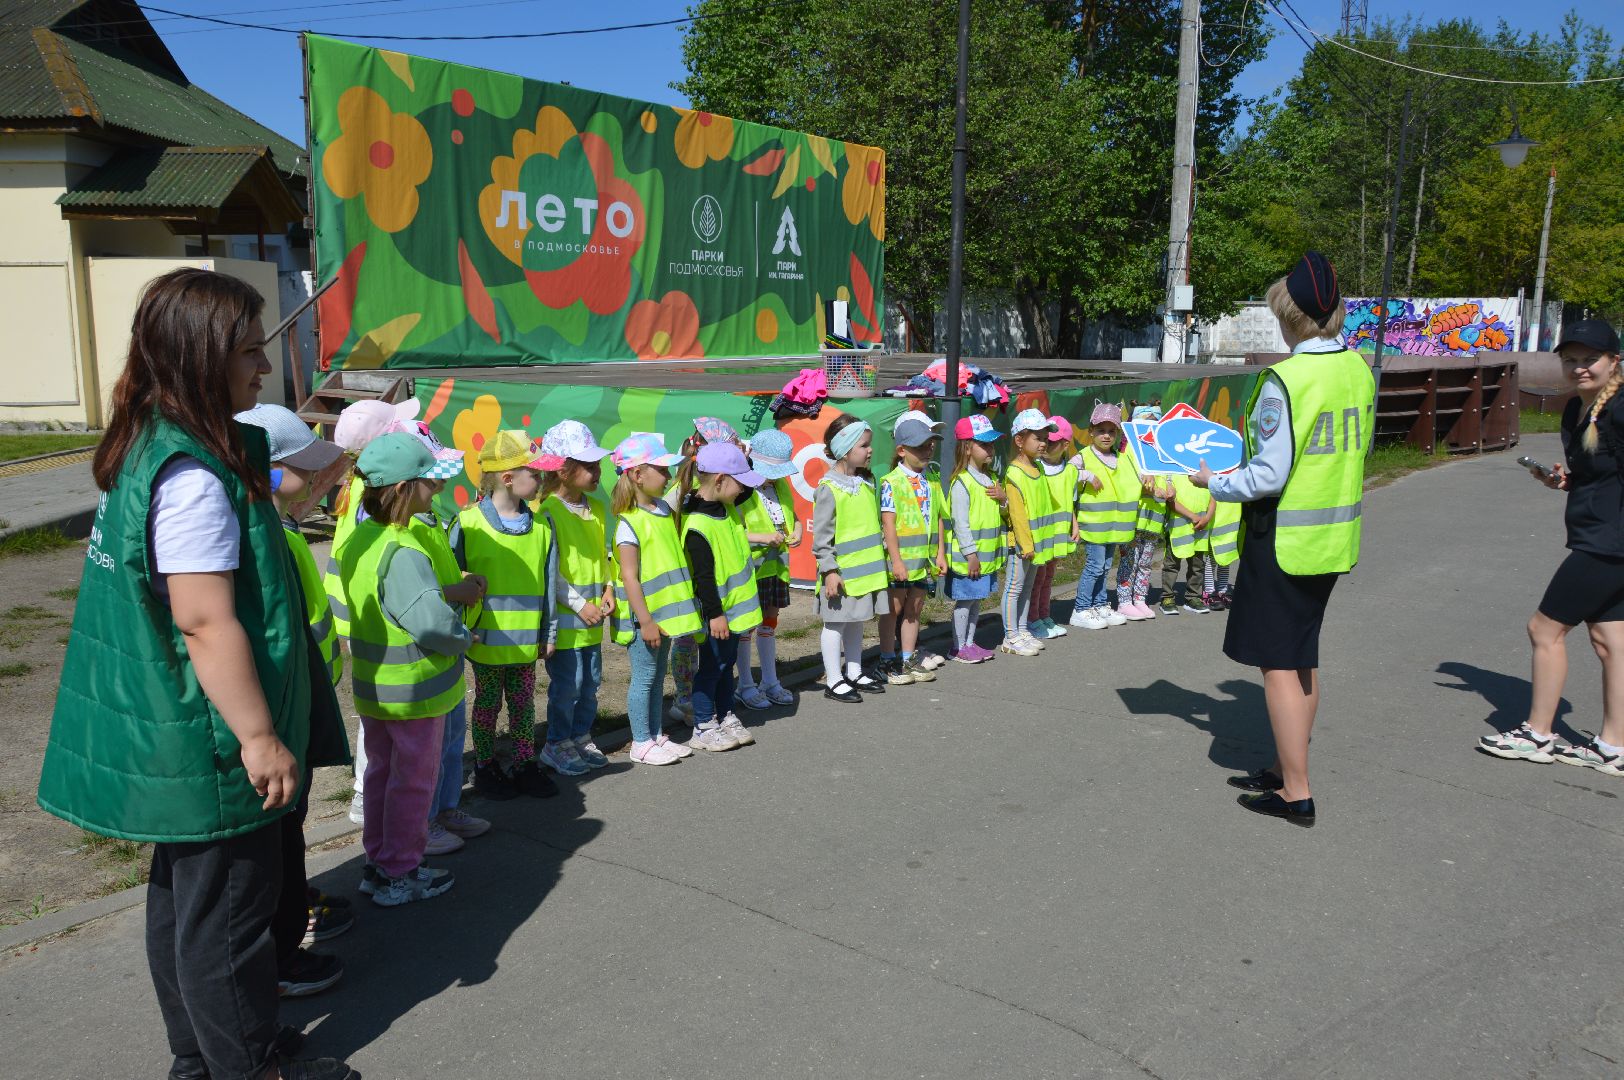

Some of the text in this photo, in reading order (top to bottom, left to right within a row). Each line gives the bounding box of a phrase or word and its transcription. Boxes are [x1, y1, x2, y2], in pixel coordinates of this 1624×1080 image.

[528, 241, 620, 255] ПОДМОСКОВЬЕ
[691, 249, 724, 263] ПАРКИ
[669, 262, 744, 277] ПОДМОСКОВЬЯ
[777, 261, 797, 271] ПАРК
[1304, 404, 1373, 455] ДП
